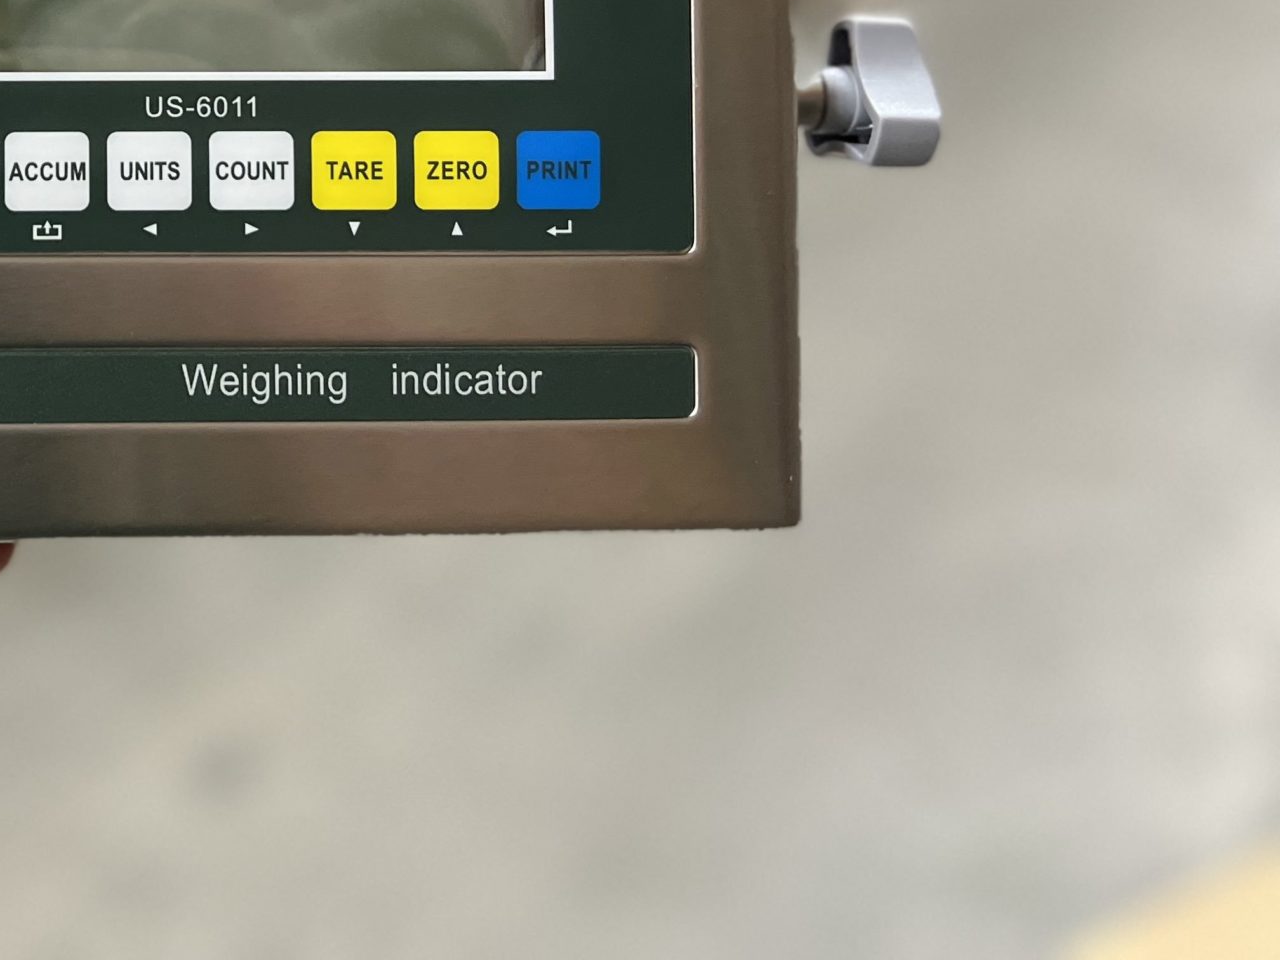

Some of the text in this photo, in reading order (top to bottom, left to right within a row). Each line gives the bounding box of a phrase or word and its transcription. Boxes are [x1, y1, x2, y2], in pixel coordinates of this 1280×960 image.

[144, 95, 258, 118] US-6011
[8, 161, 86, 182] ACCUM
[119, 161, 181, 181] UNITS
[215, 160, 289, 181] COUNT
[326, 161, 384, 181] TARE
[426, 160, 488, 181] ZERO
[526, 160, 592, 180] PRINT
[181, 362, 542, 405] Weighing indicator
